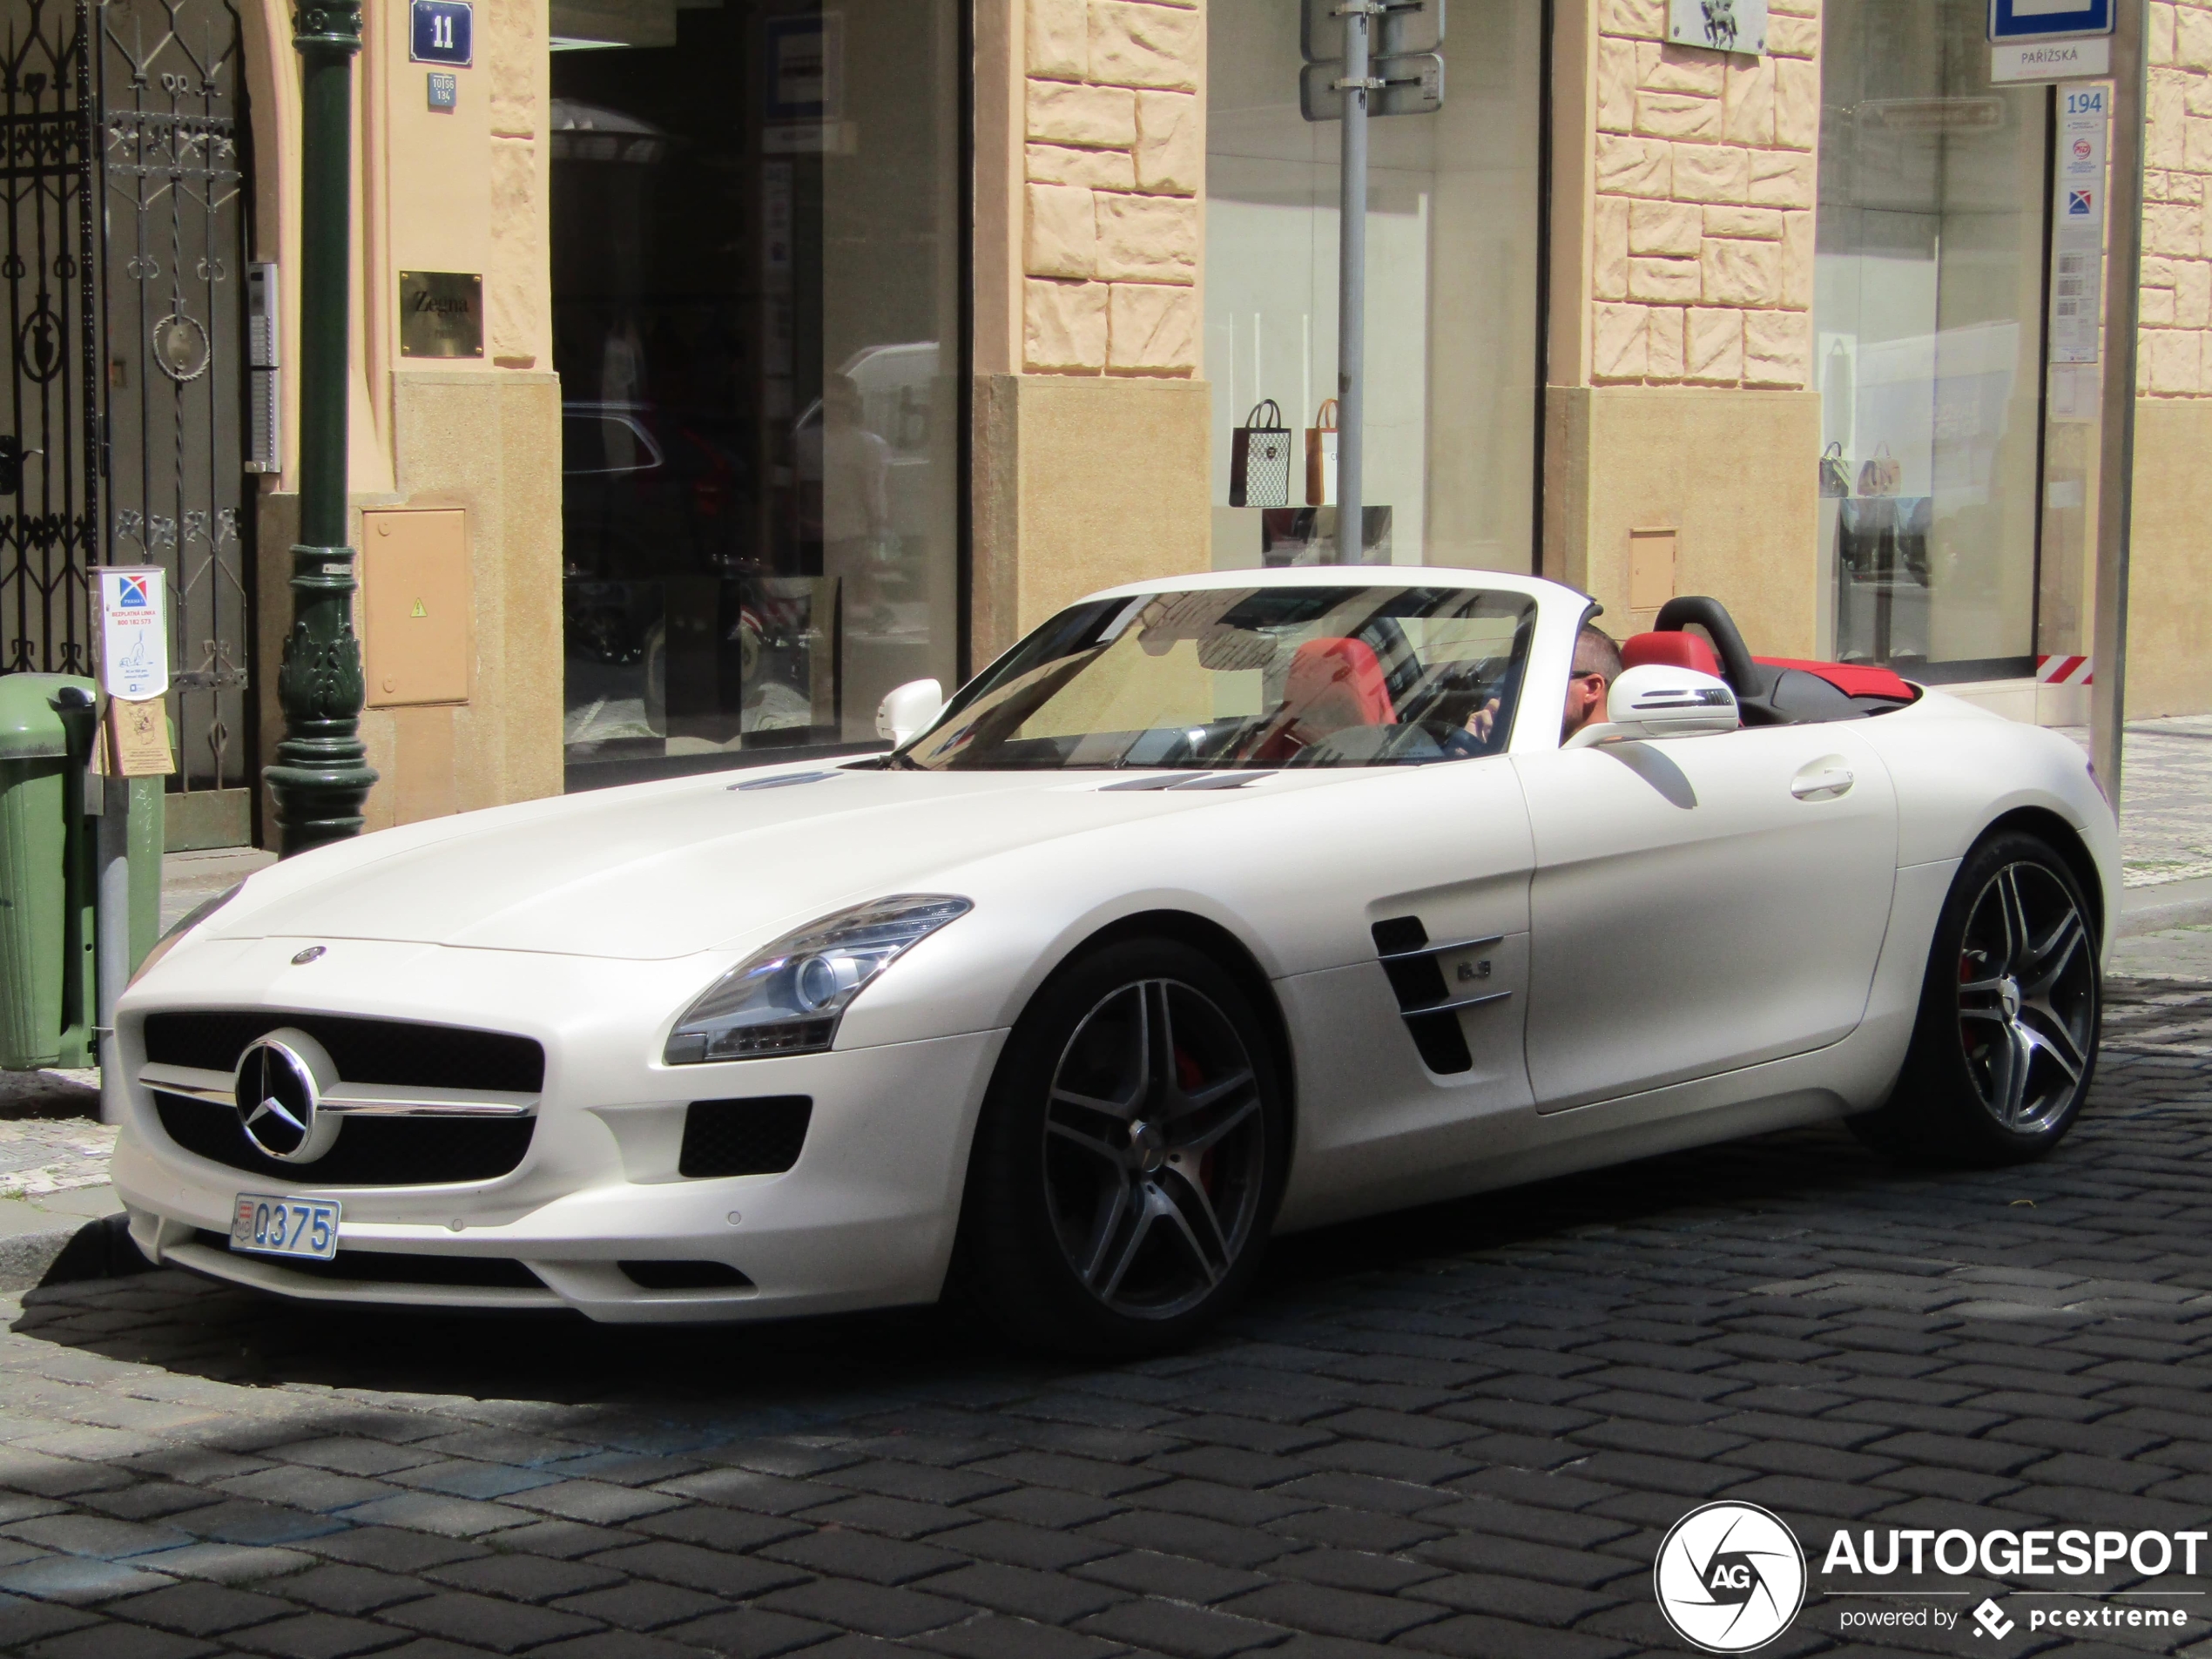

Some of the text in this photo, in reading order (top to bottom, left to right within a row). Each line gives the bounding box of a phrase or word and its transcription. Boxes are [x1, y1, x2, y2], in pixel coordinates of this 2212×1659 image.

[434, 15, 453, 49] 11
[2020, 45, 2078, 64] PAŘÍŽSKÁ
[2067, 92, 2101, 114] 194
[413, 290, 469, 318] Zegna
